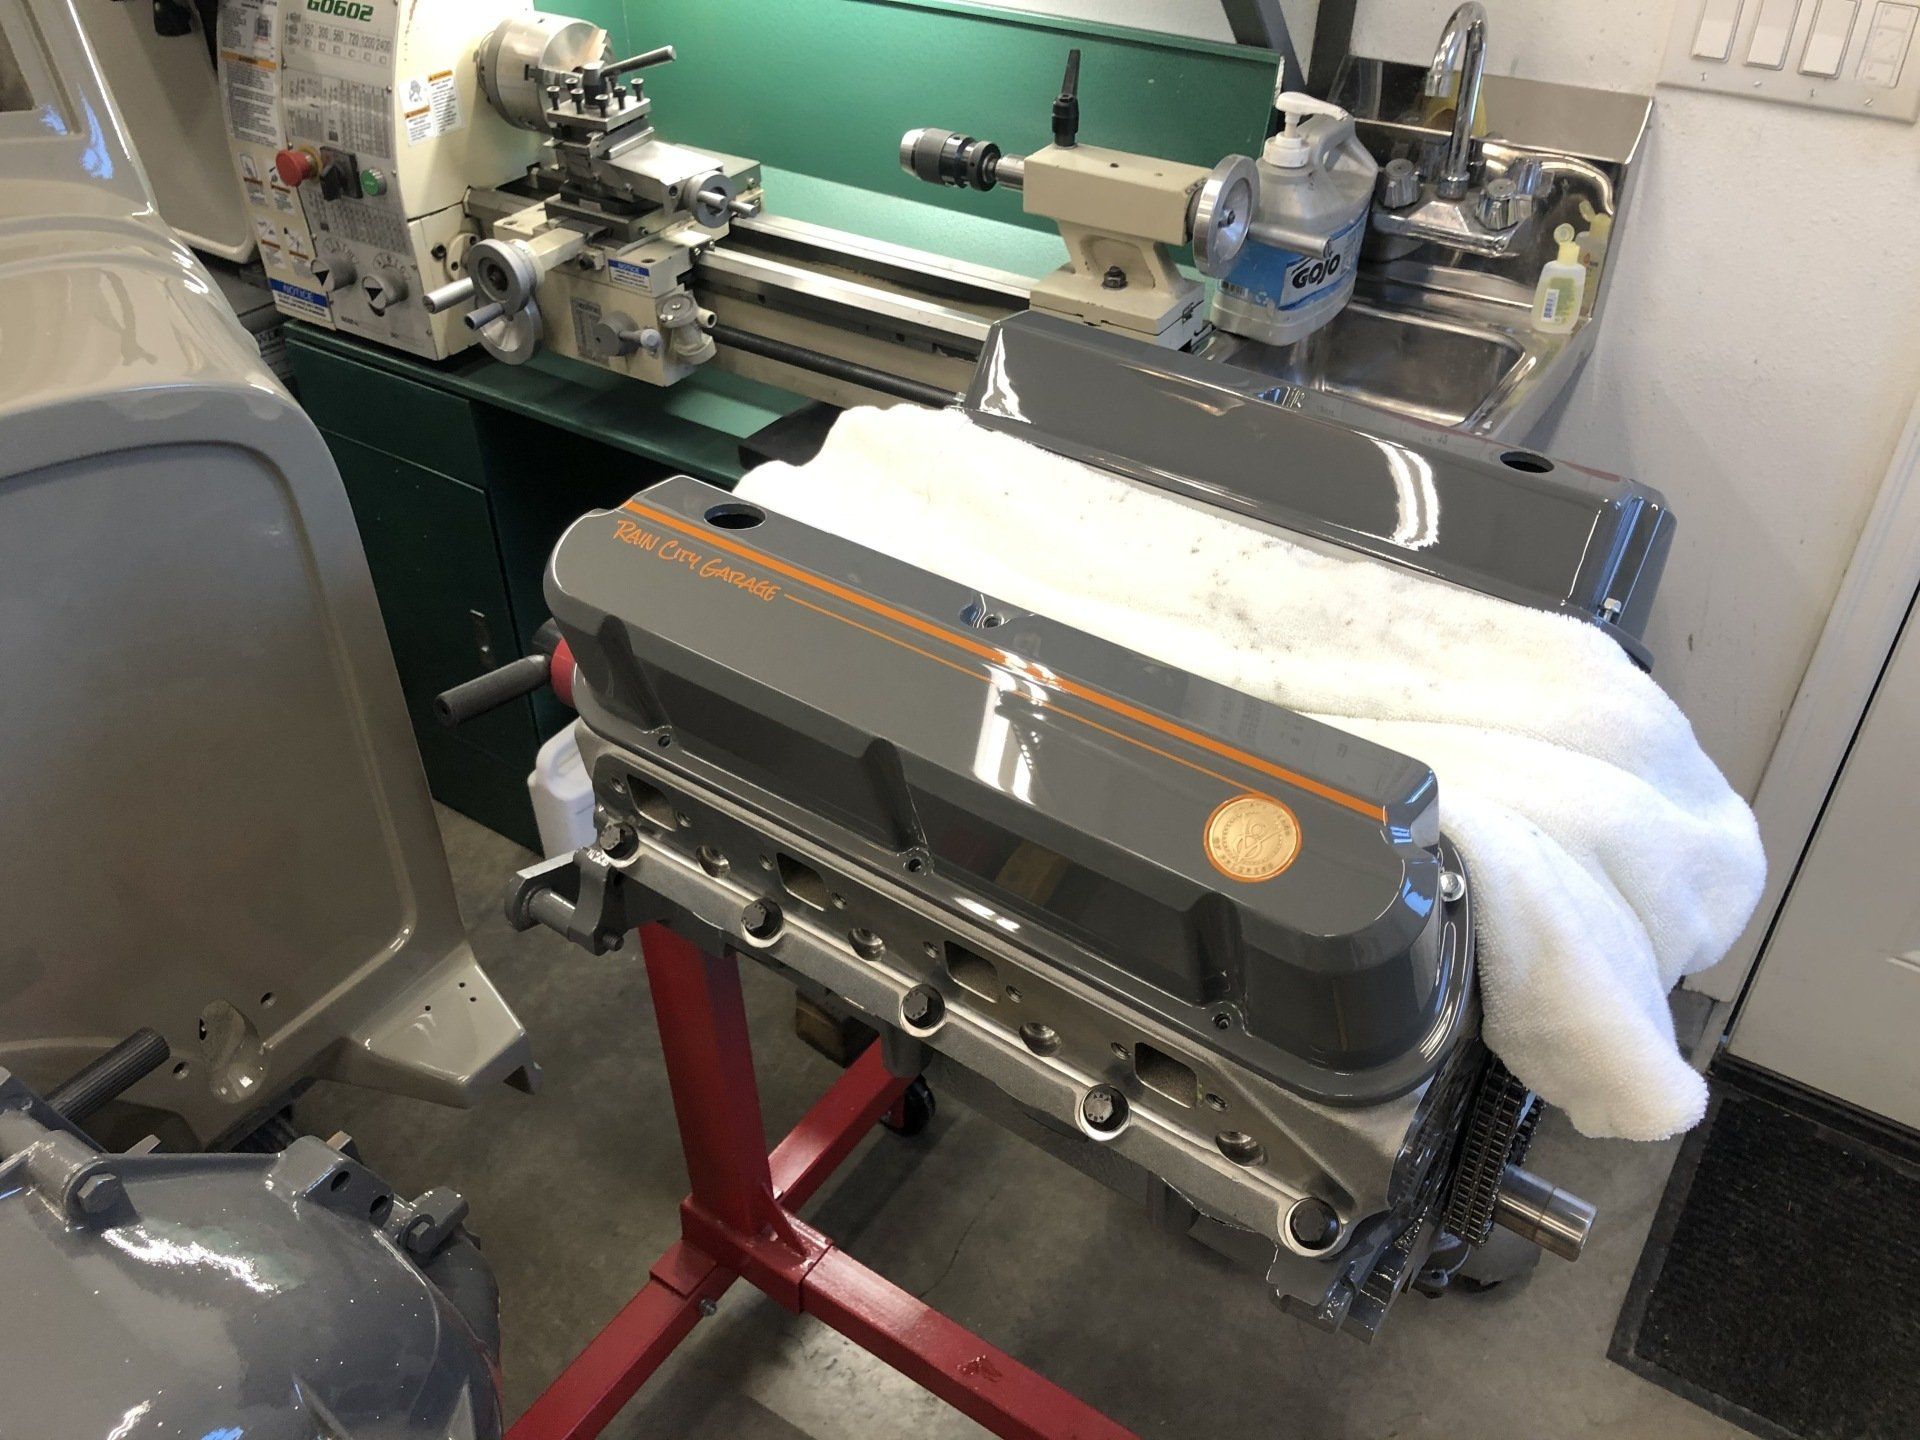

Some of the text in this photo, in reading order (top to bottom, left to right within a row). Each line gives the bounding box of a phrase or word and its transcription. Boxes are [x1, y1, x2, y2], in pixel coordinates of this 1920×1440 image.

[1292, 254, 1340, 288] GOJO
[283, 284, 313, 301] NOTICE
[613, 520, 660, 550] RAIN
[699, 558, 781, 602] GARAGE
